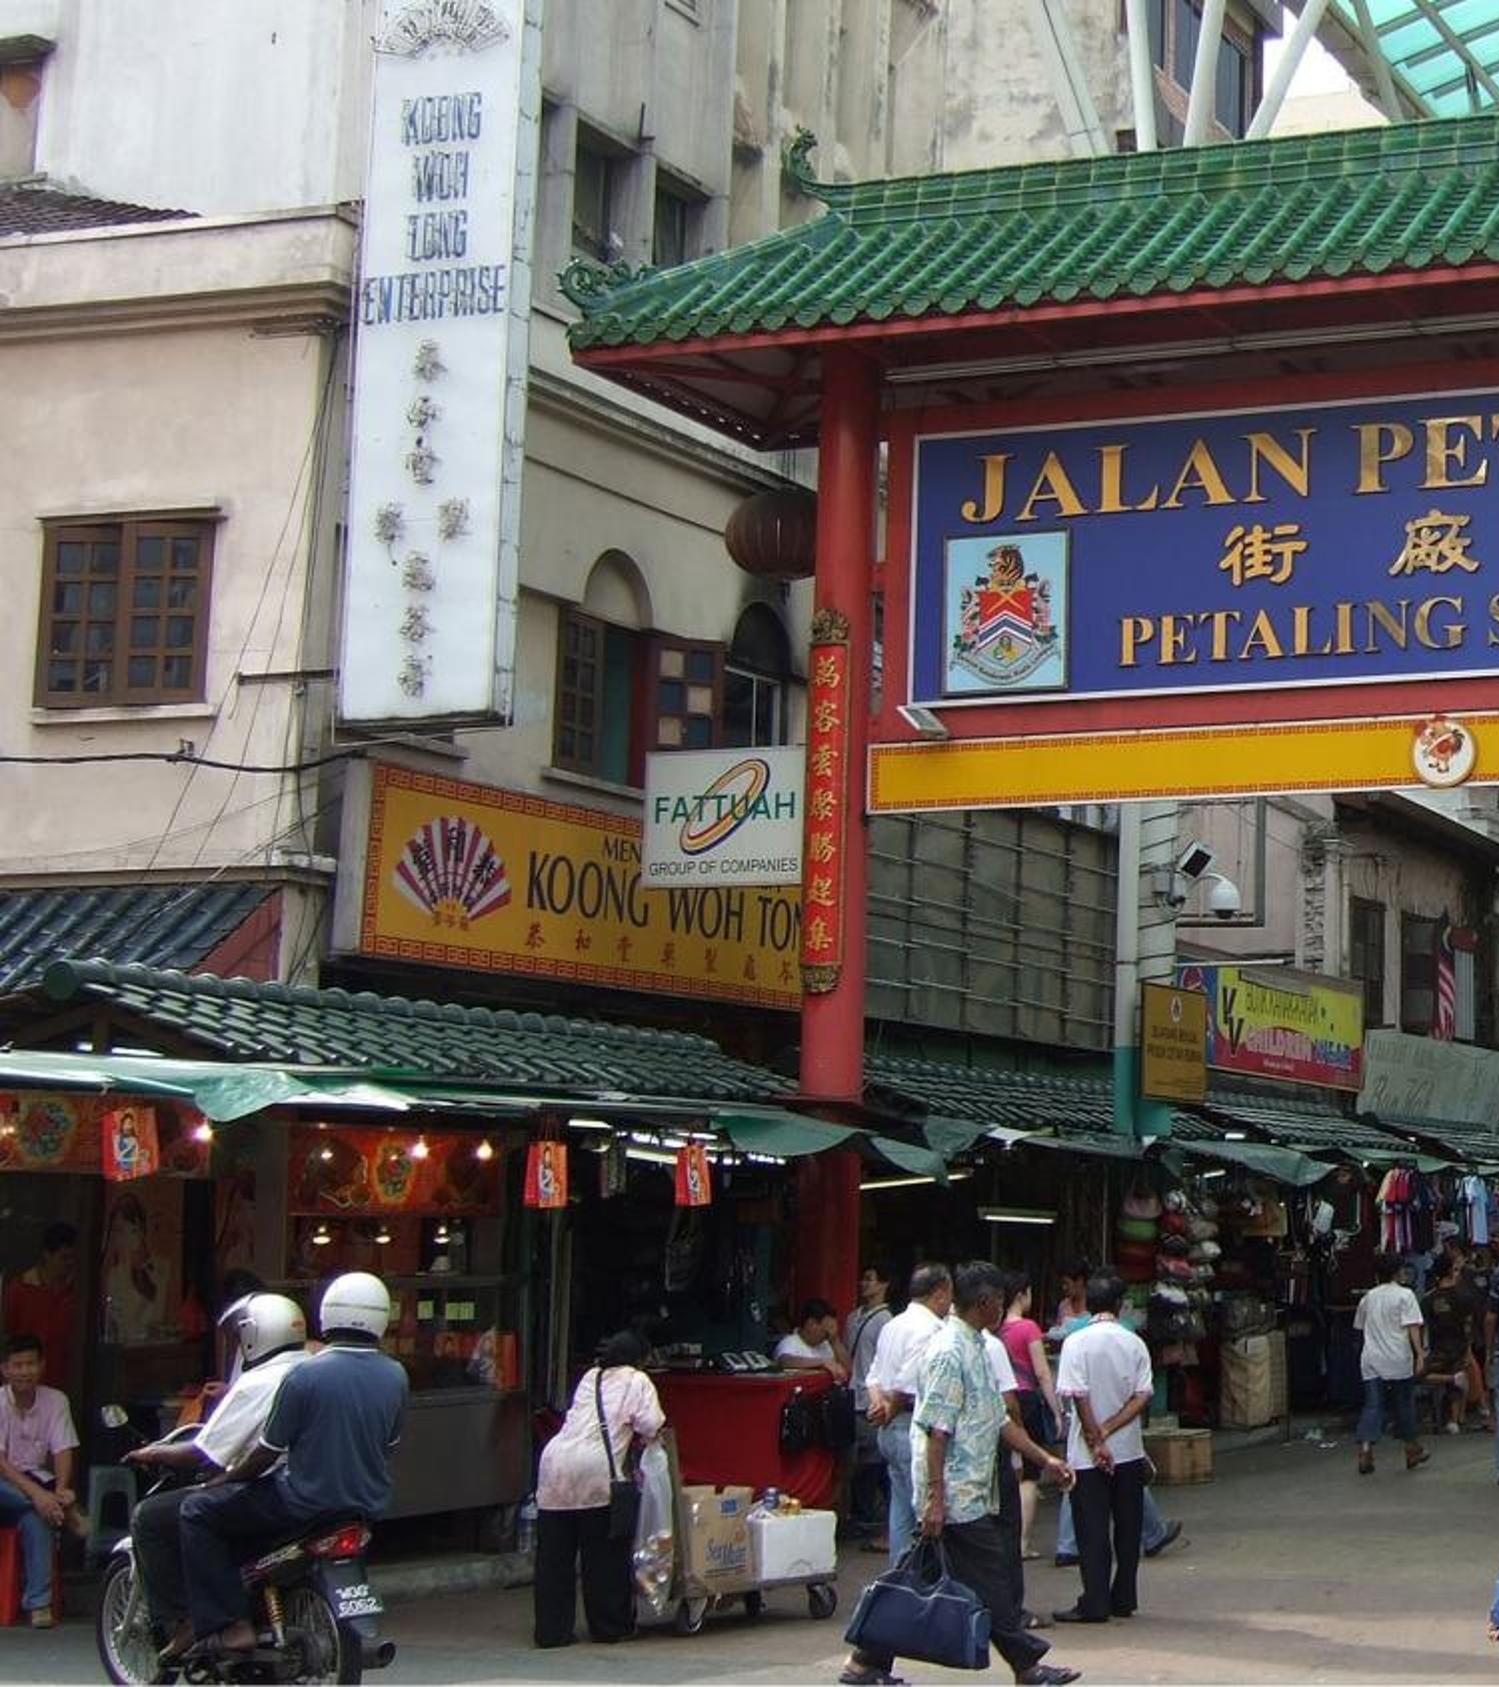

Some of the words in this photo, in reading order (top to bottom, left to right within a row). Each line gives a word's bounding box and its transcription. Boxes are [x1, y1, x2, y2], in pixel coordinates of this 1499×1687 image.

[402, 92, 482, 146] KOONG
[412, 151, 469, 201] WOH
[407, 210, 468, 261] TONG
[362, 265, 506, 325] ENTERPRISE
[961, 427, 1317, 525] JALAN
[1119, 597, 1464, 668] PETALING
[655, 791, 796, 824] FATTUAH
[527, 851, 648, 928] KOONG
[649, 861, 697, 877] GROUP
[700, 860, 717, 875] OF
[720, 857, 799, 874] COMPANIES
[669, 886, 744, 943] WOH
